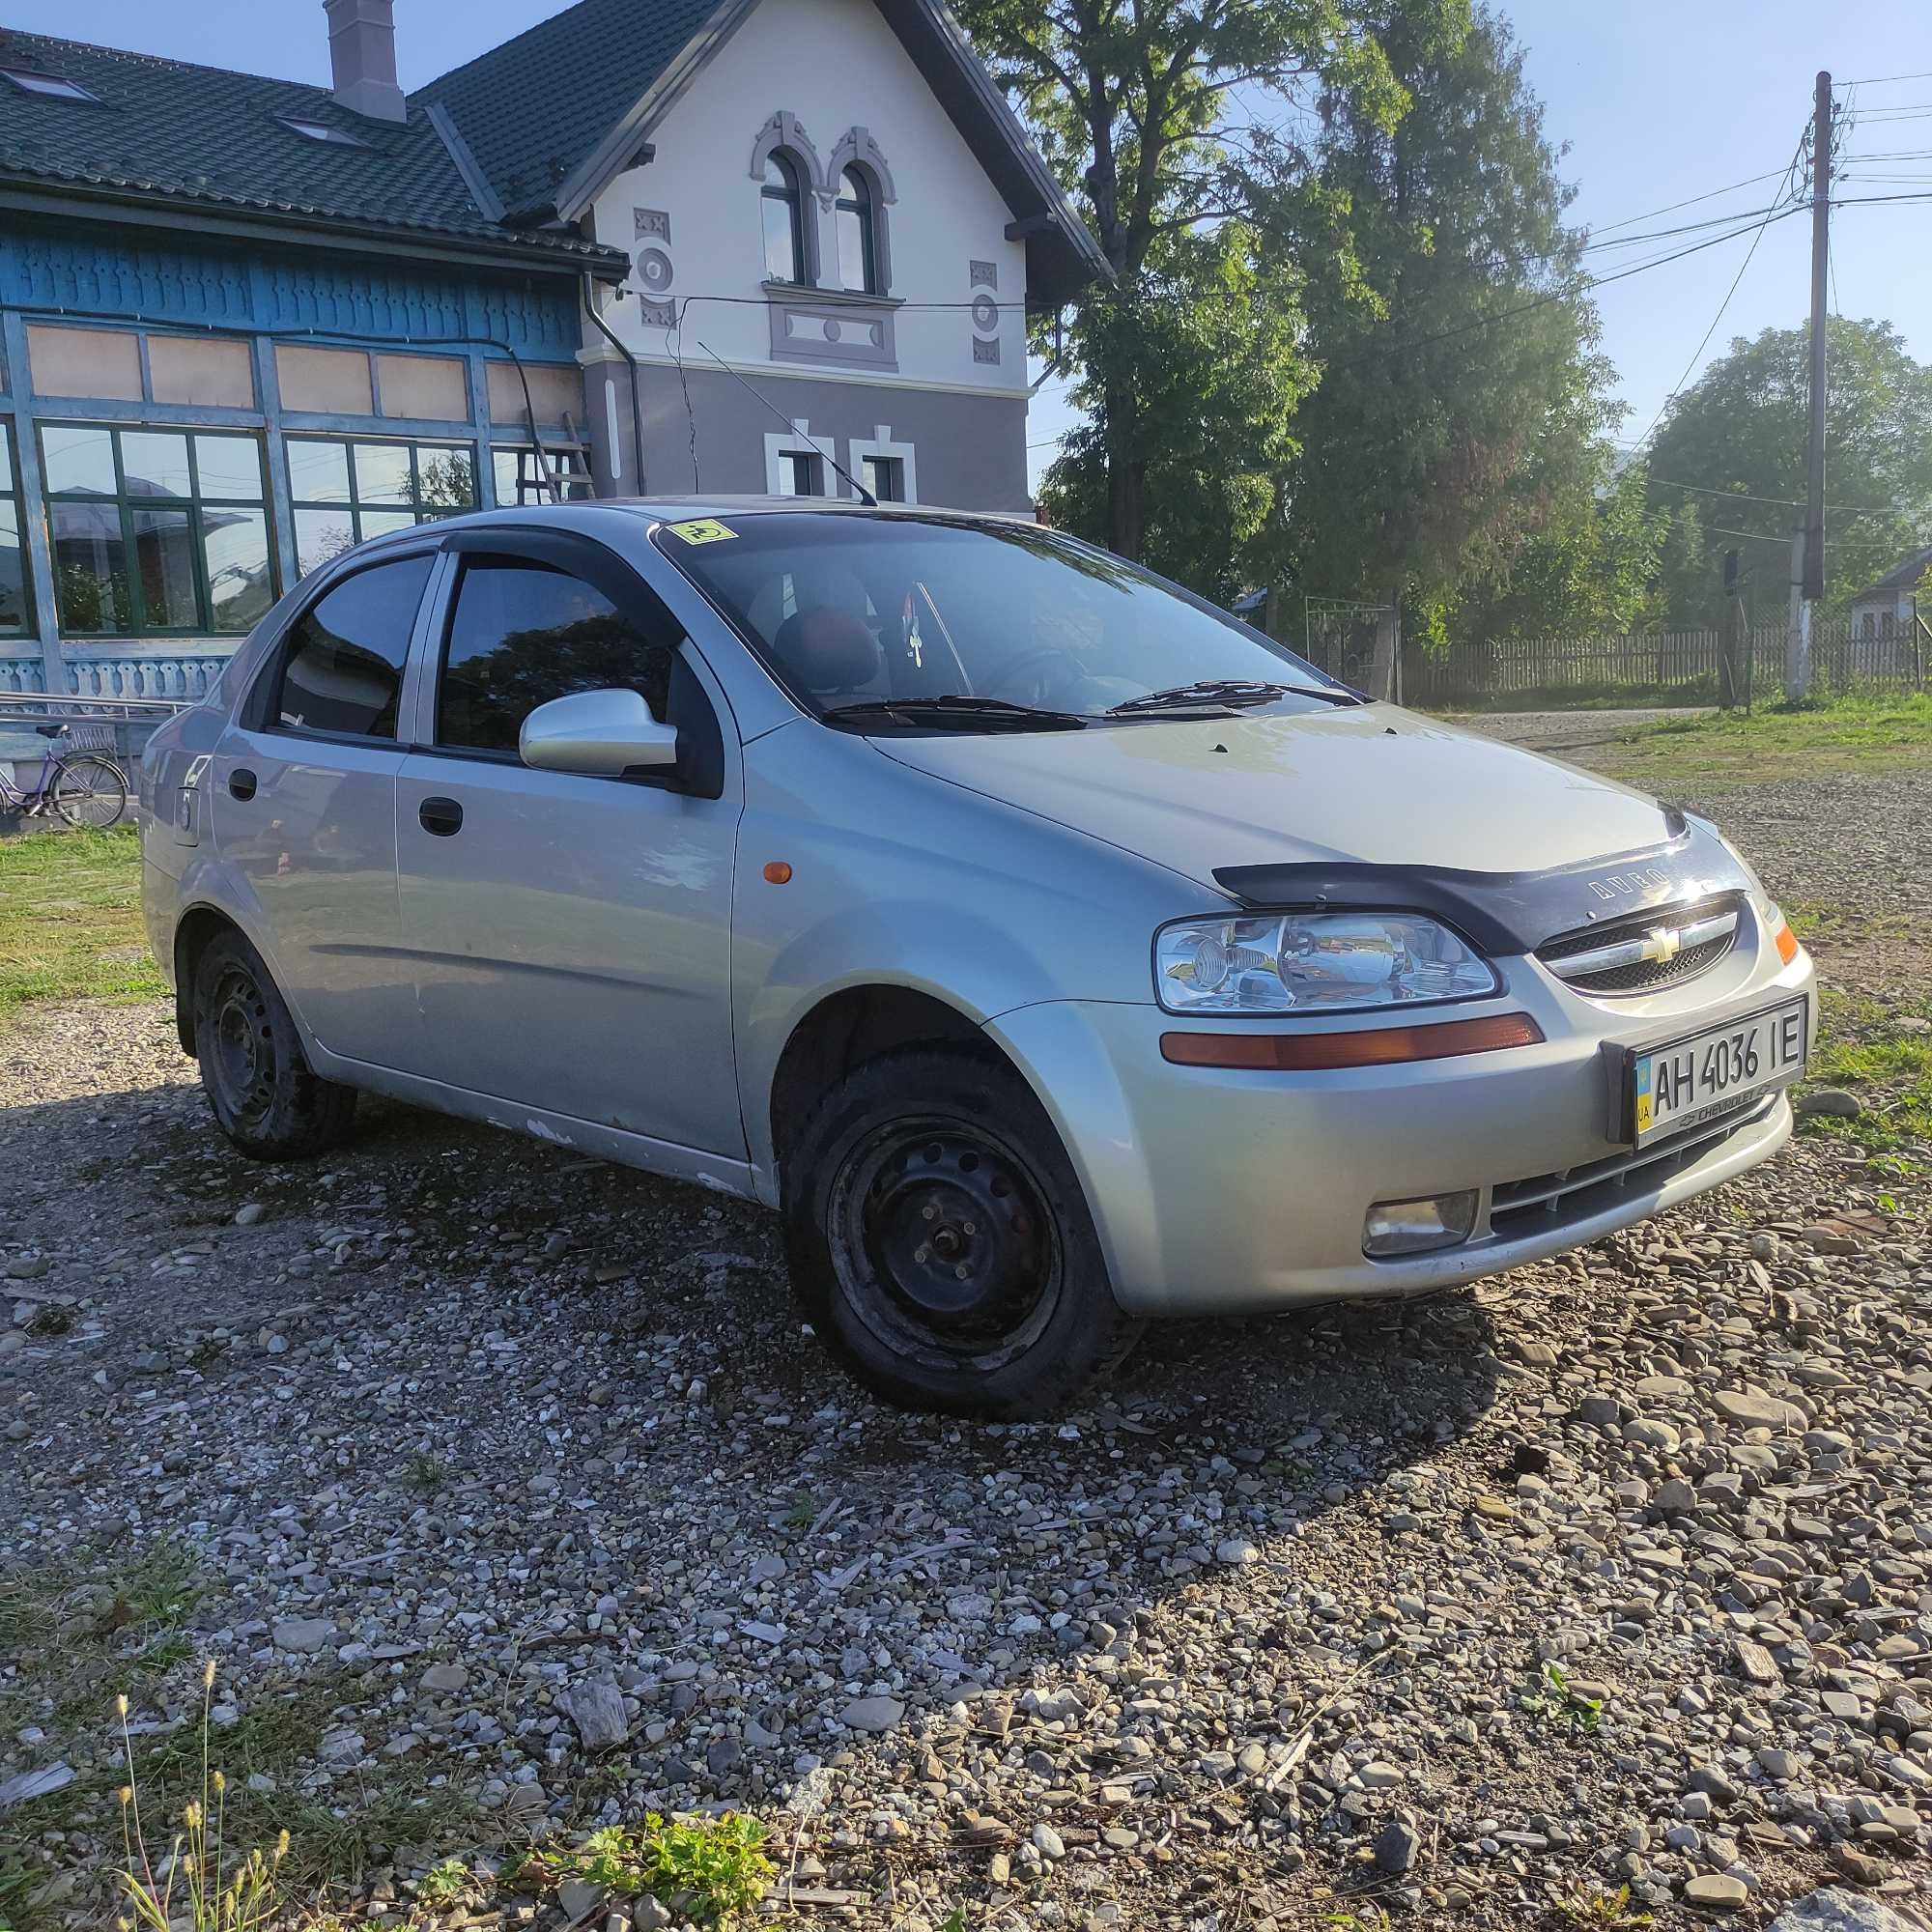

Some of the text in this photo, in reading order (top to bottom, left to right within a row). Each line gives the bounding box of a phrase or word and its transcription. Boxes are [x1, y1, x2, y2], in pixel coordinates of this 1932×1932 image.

[1588, 868, 1670, 900] AVEO
[1655, 1010, 1800, 1116] AH 4036 IE
[1637, 1107, 1650, 1122] UA
[1698, 1092, 1754, 1121] CHEVROLET
